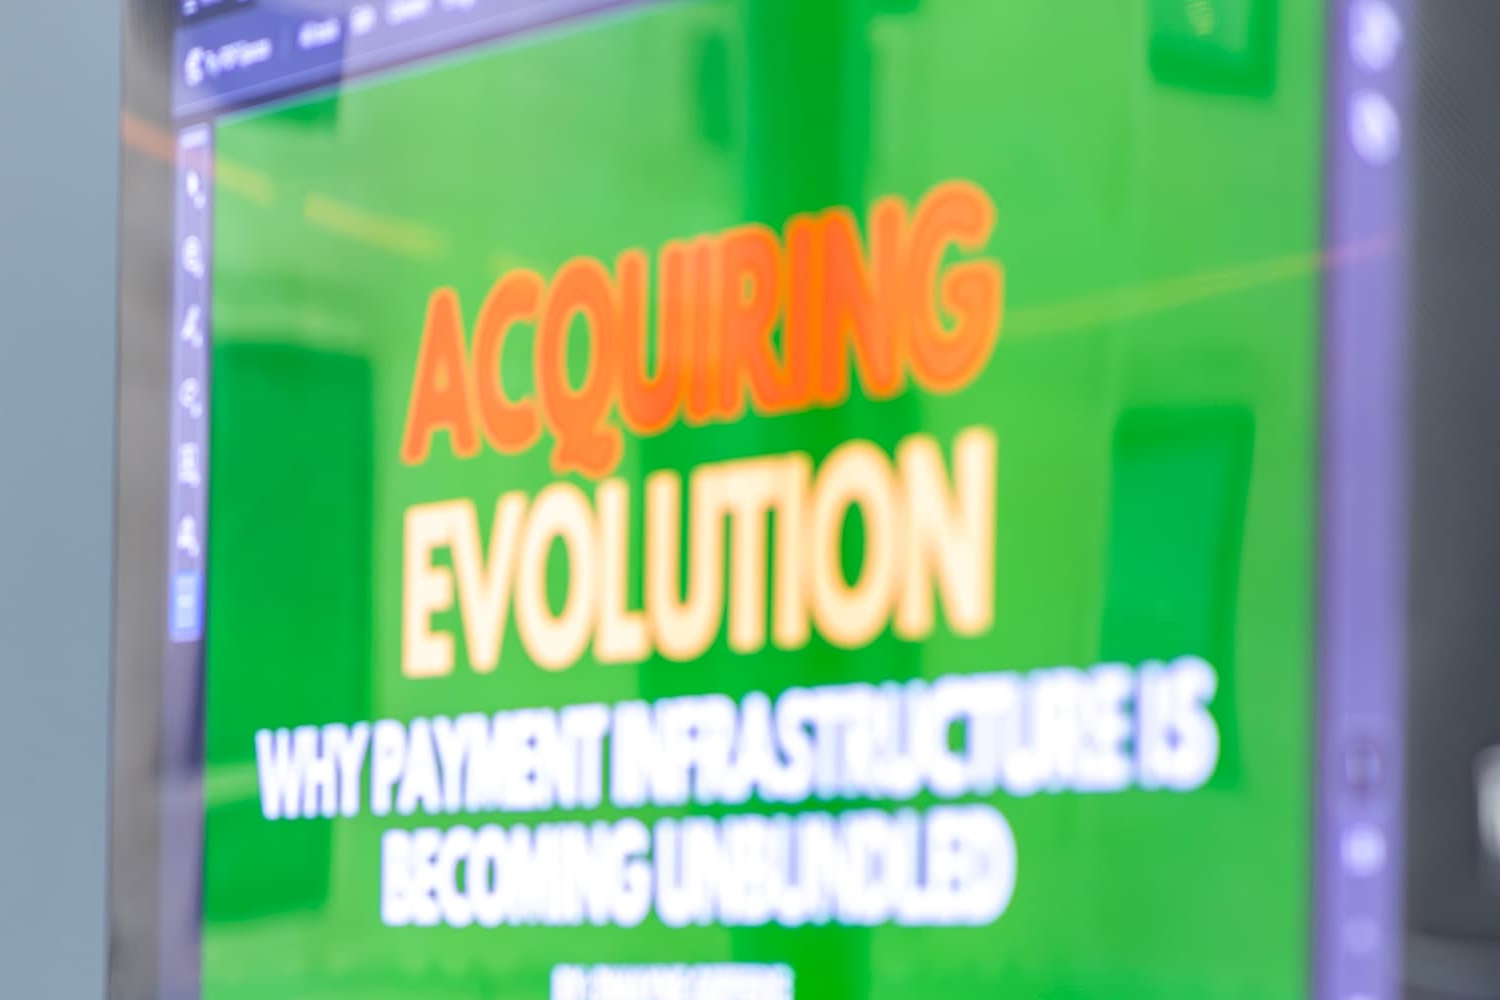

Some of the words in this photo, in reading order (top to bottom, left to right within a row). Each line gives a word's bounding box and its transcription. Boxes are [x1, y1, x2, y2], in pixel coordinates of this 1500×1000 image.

[401, 178, 1004, 481] ACQUIRING
[401, 424, 998, 680] EVOLUTION
[255, 719, 373, 820] WHY
[370, 702, 611, 816] PAYMENT
[609, 660, 1134, 809] INFRASTRUCTURE
[1133, 655, 1220, 792] IS
[380, 817, 652, 928] BECOMING
[652, 803, 1019, 928] UNBUNDLED
